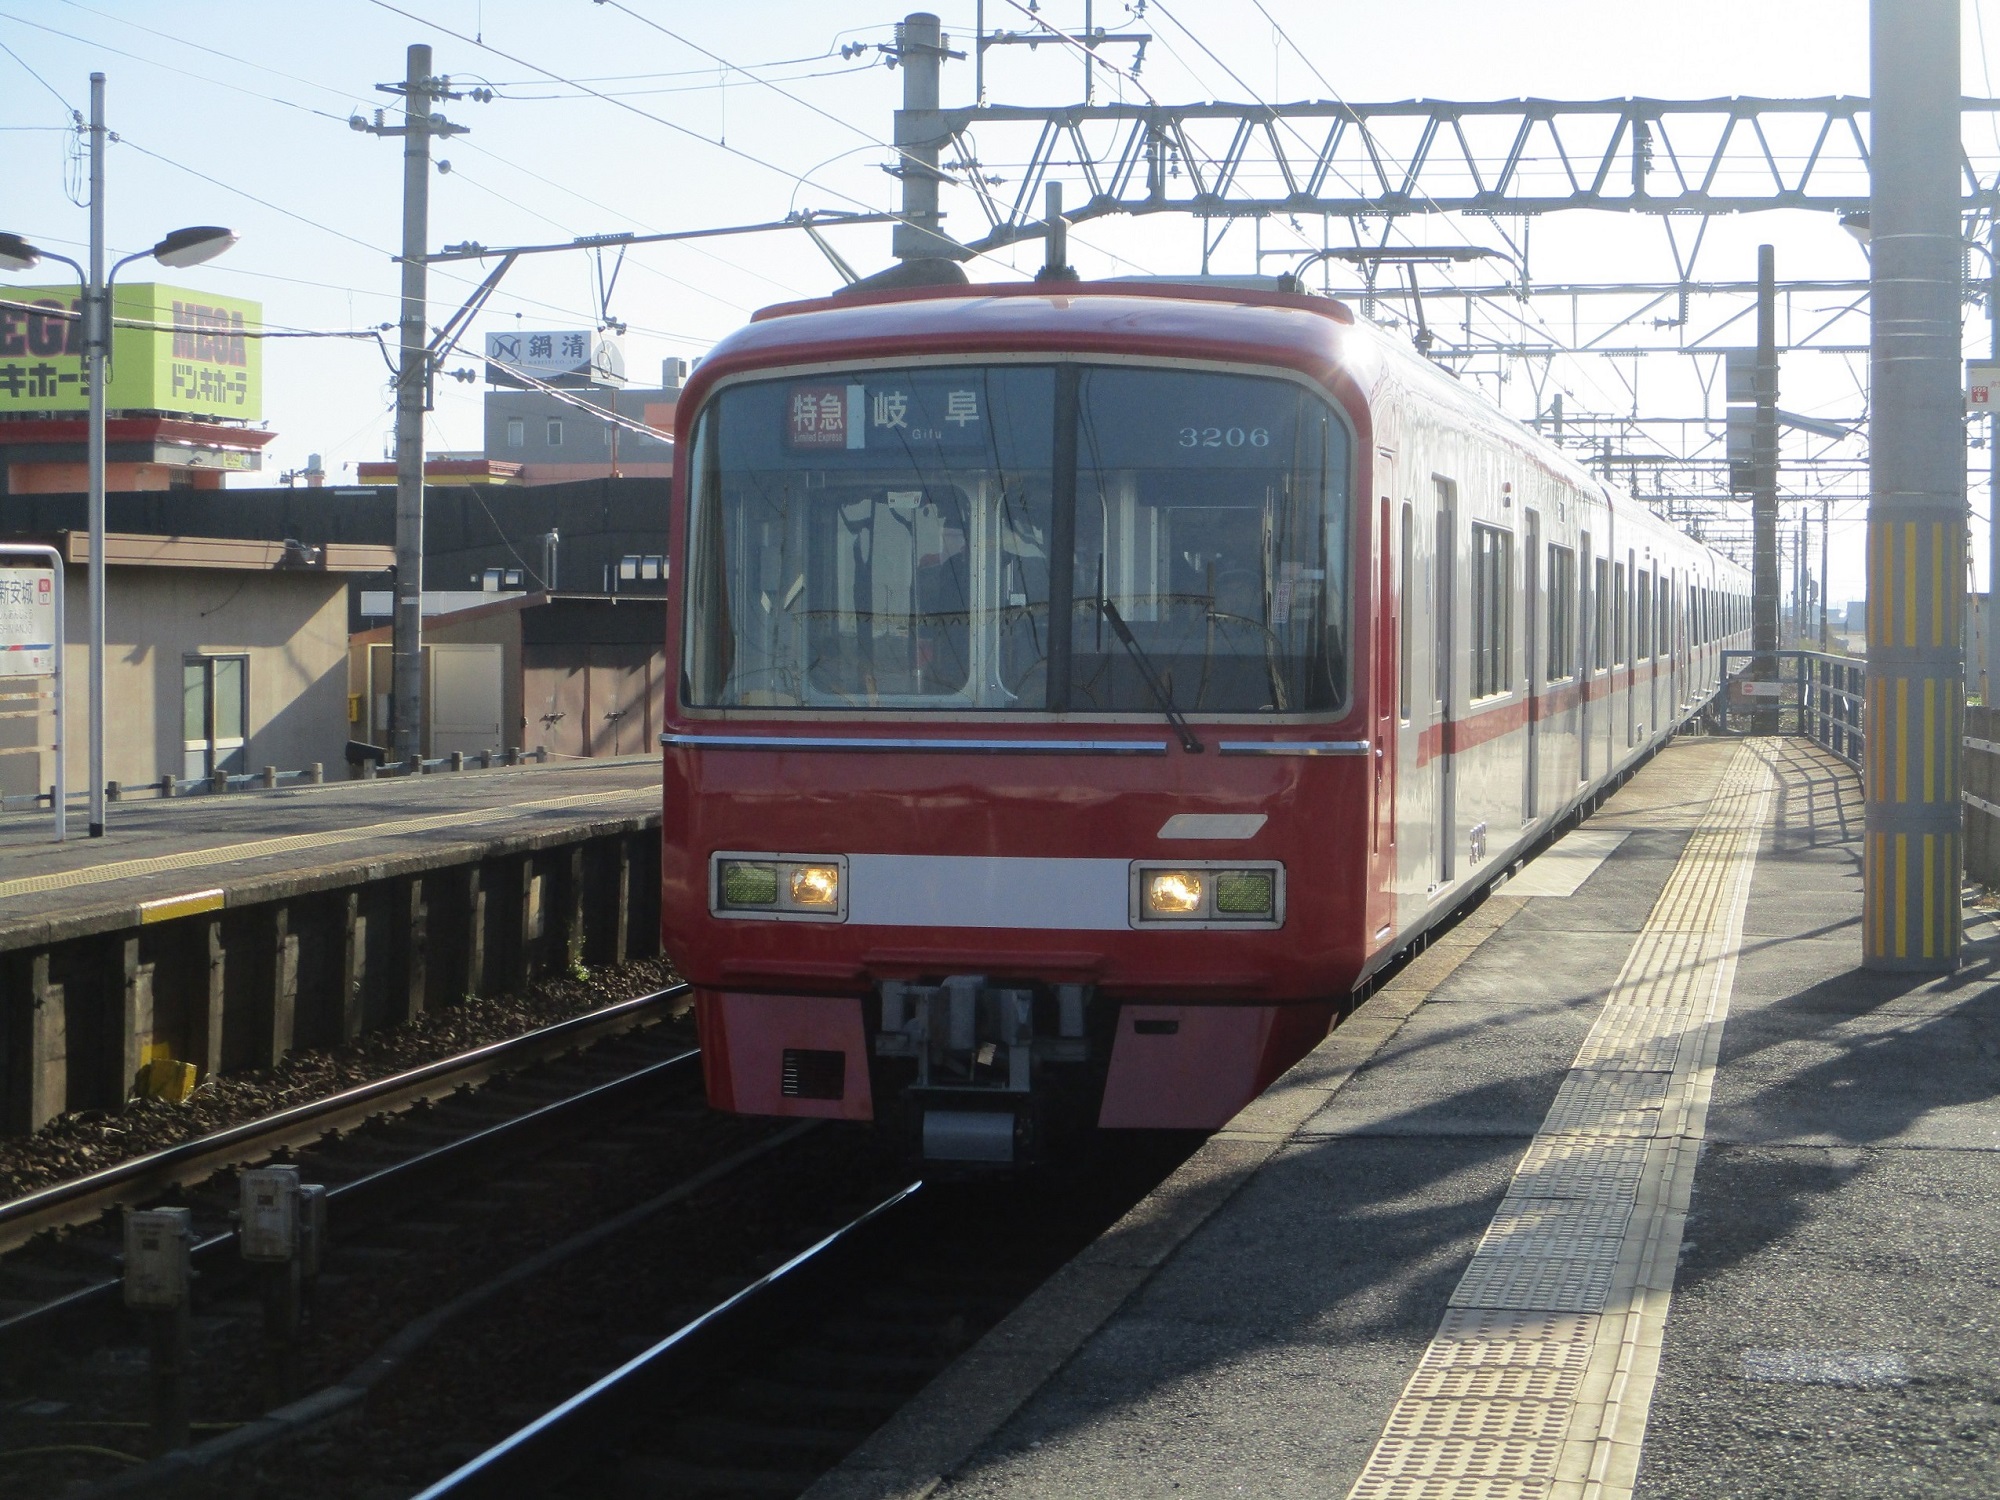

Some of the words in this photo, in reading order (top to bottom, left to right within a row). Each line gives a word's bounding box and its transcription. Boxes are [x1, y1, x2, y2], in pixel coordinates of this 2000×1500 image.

[172, 300, 247, 367] MEGA
[528, 334, 585, 358] 鍋清
[793, 393, 843, 431] 特急
[873, 390, 979, 428] 岐阜
[912, 429, 942, 440] Gifu
[1179, 427, 1269, 447] 3206
